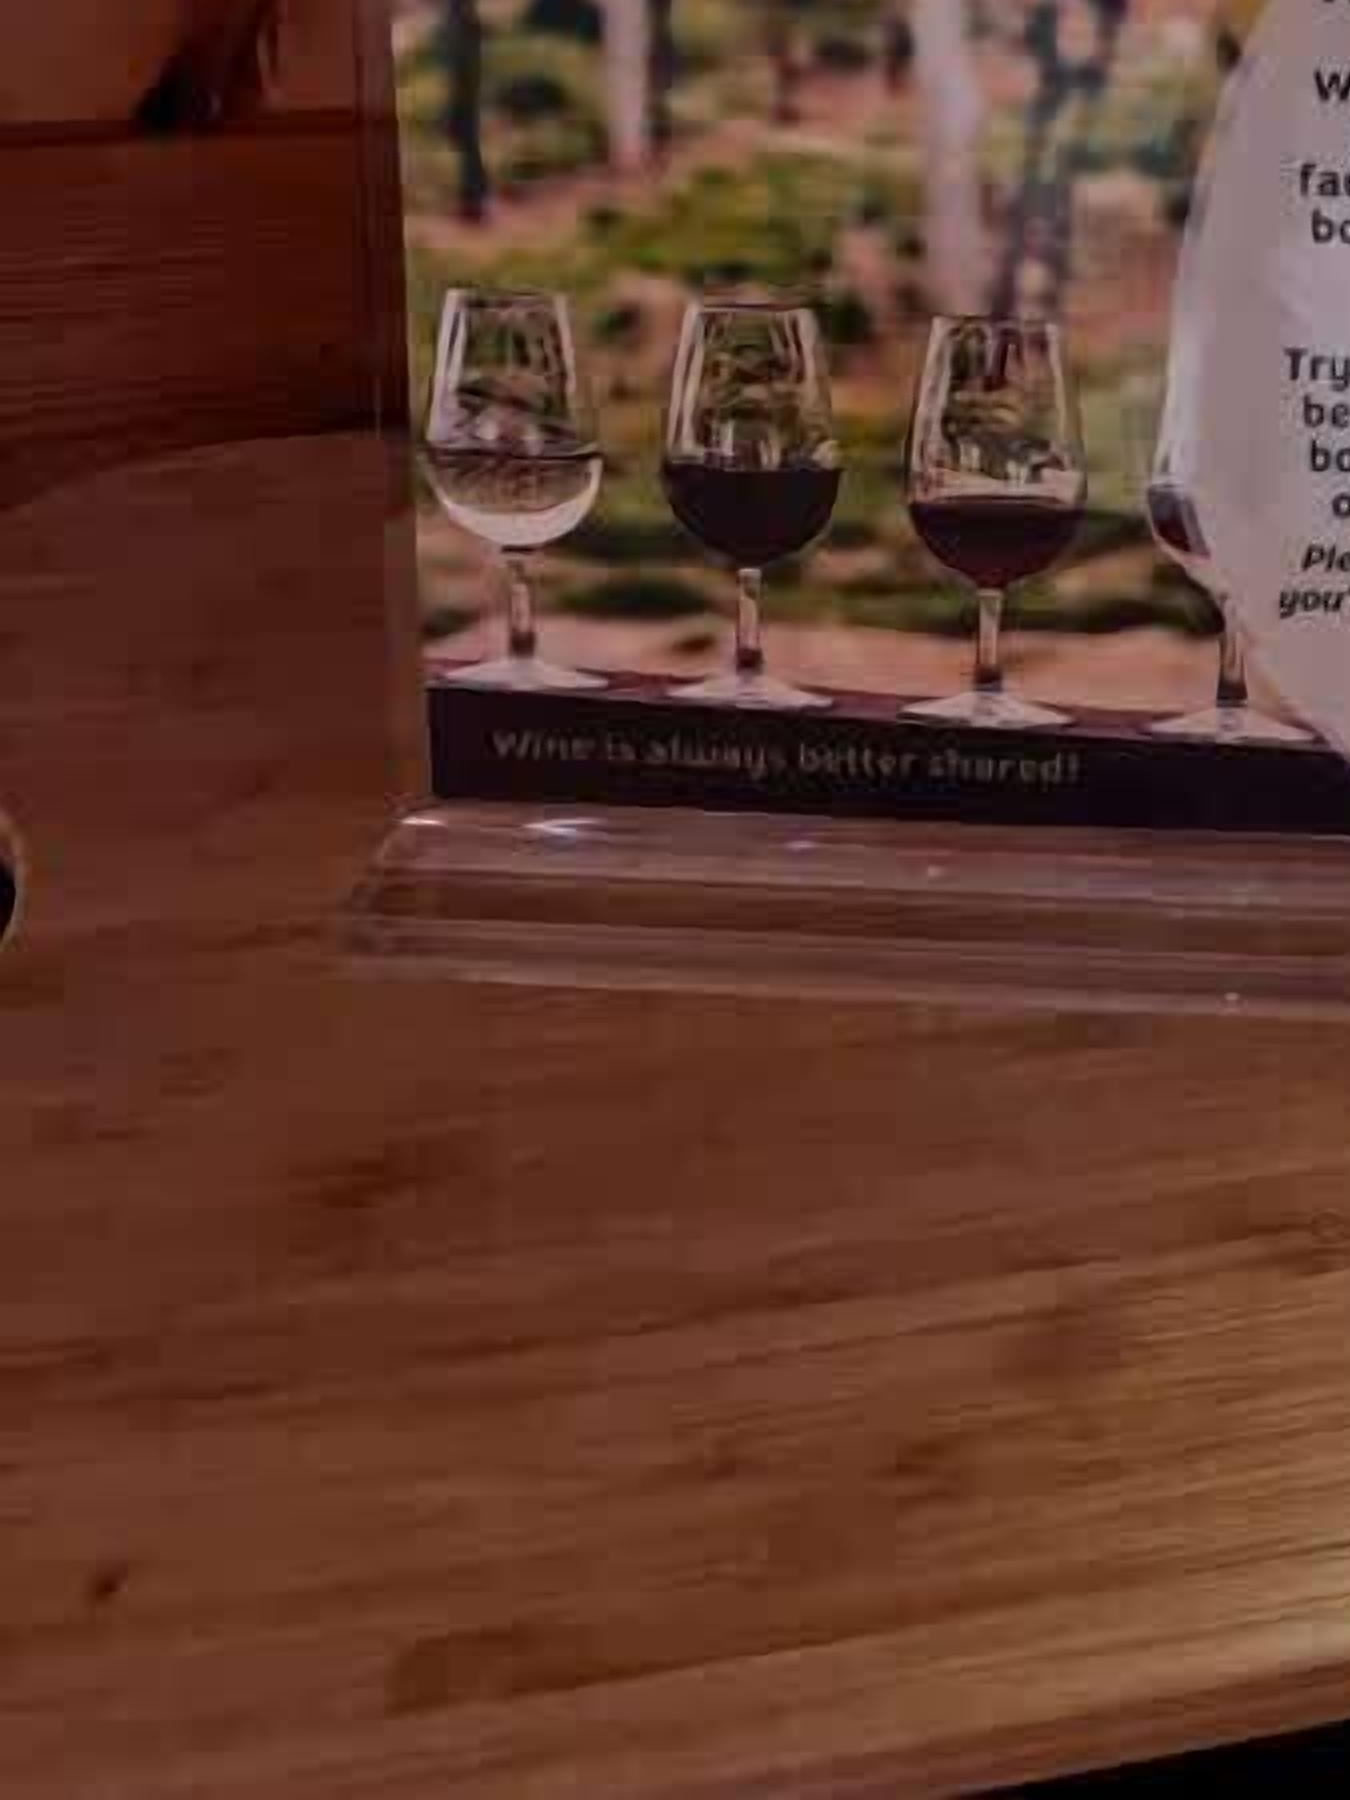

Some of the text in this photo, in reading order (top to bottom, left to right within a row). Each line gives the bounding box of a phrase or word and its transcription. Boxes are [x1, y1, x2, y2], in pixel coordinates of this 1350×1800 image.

[1303, 397, 1350, 430] be
[491, 732, 596, 762] Wine
[798, 737, 913, 777] better
[928, 747, 1082, 786] shared!
